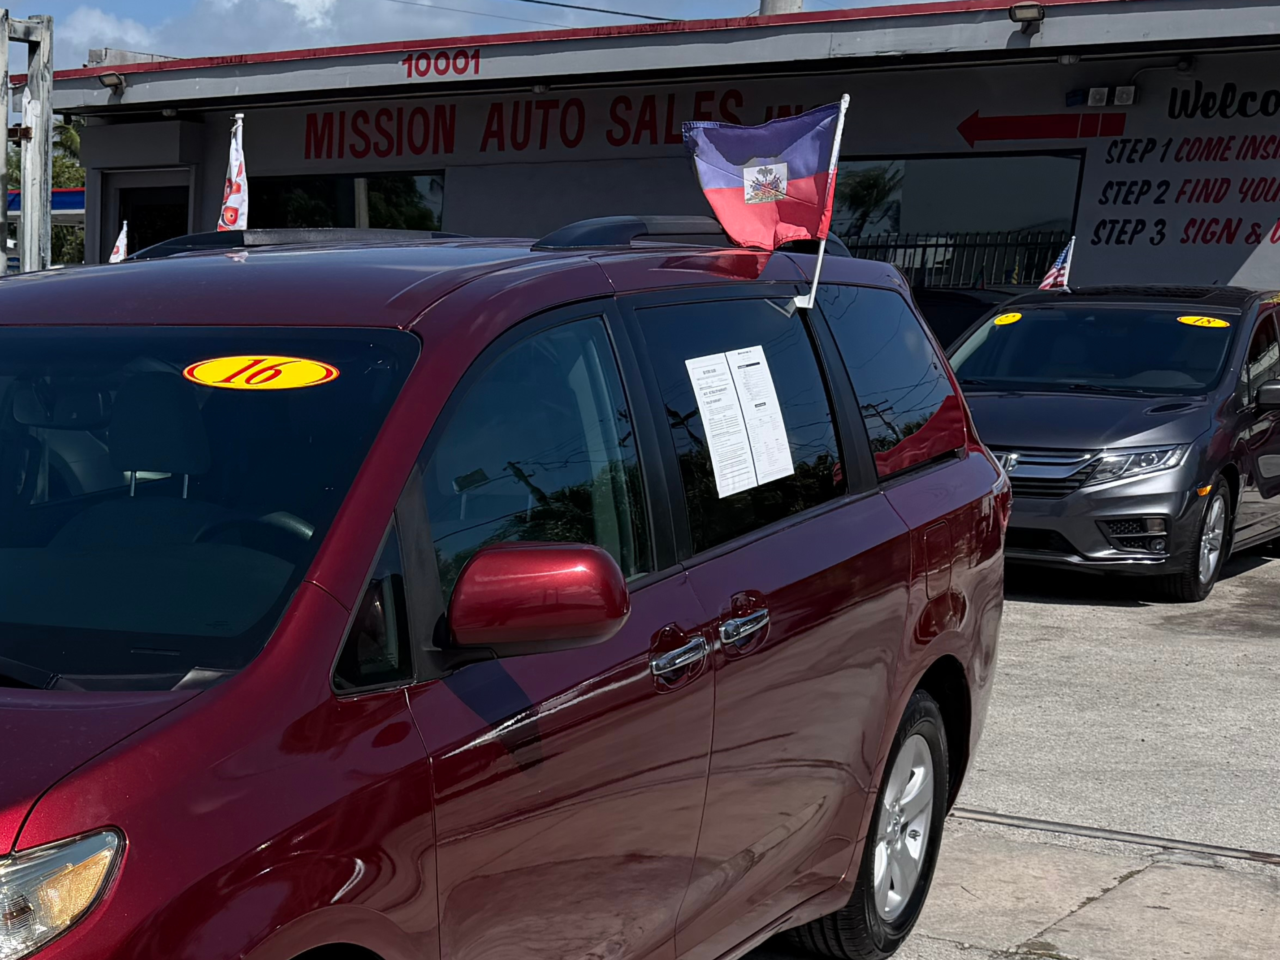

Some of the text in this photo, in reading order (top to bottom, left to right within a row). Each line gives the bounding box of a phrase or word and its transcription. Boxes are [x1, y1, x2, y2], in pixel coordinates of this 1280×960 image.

[402, 49, 481, 78] 10001
[304, 89, 744, 160] MISSION AUTO SALES
[1105, 137, 1157, 164] STEP
[1160, 137, 1173, 163] 1
[1174, 135, 1236, 163] COME
[1098, 179, 1152, 205] STEP
[1153, 179, 1171, 204] 2
[1175, 177, 1232, 204] FIND
[1090, 218, 1147, 246] STEP
[1149, 218, 1167, 246] 3
[1180, 216, 1243, 245] SIGN
[1244, 222, 1262, 245] &
[212, 358, 302, 386] 16
